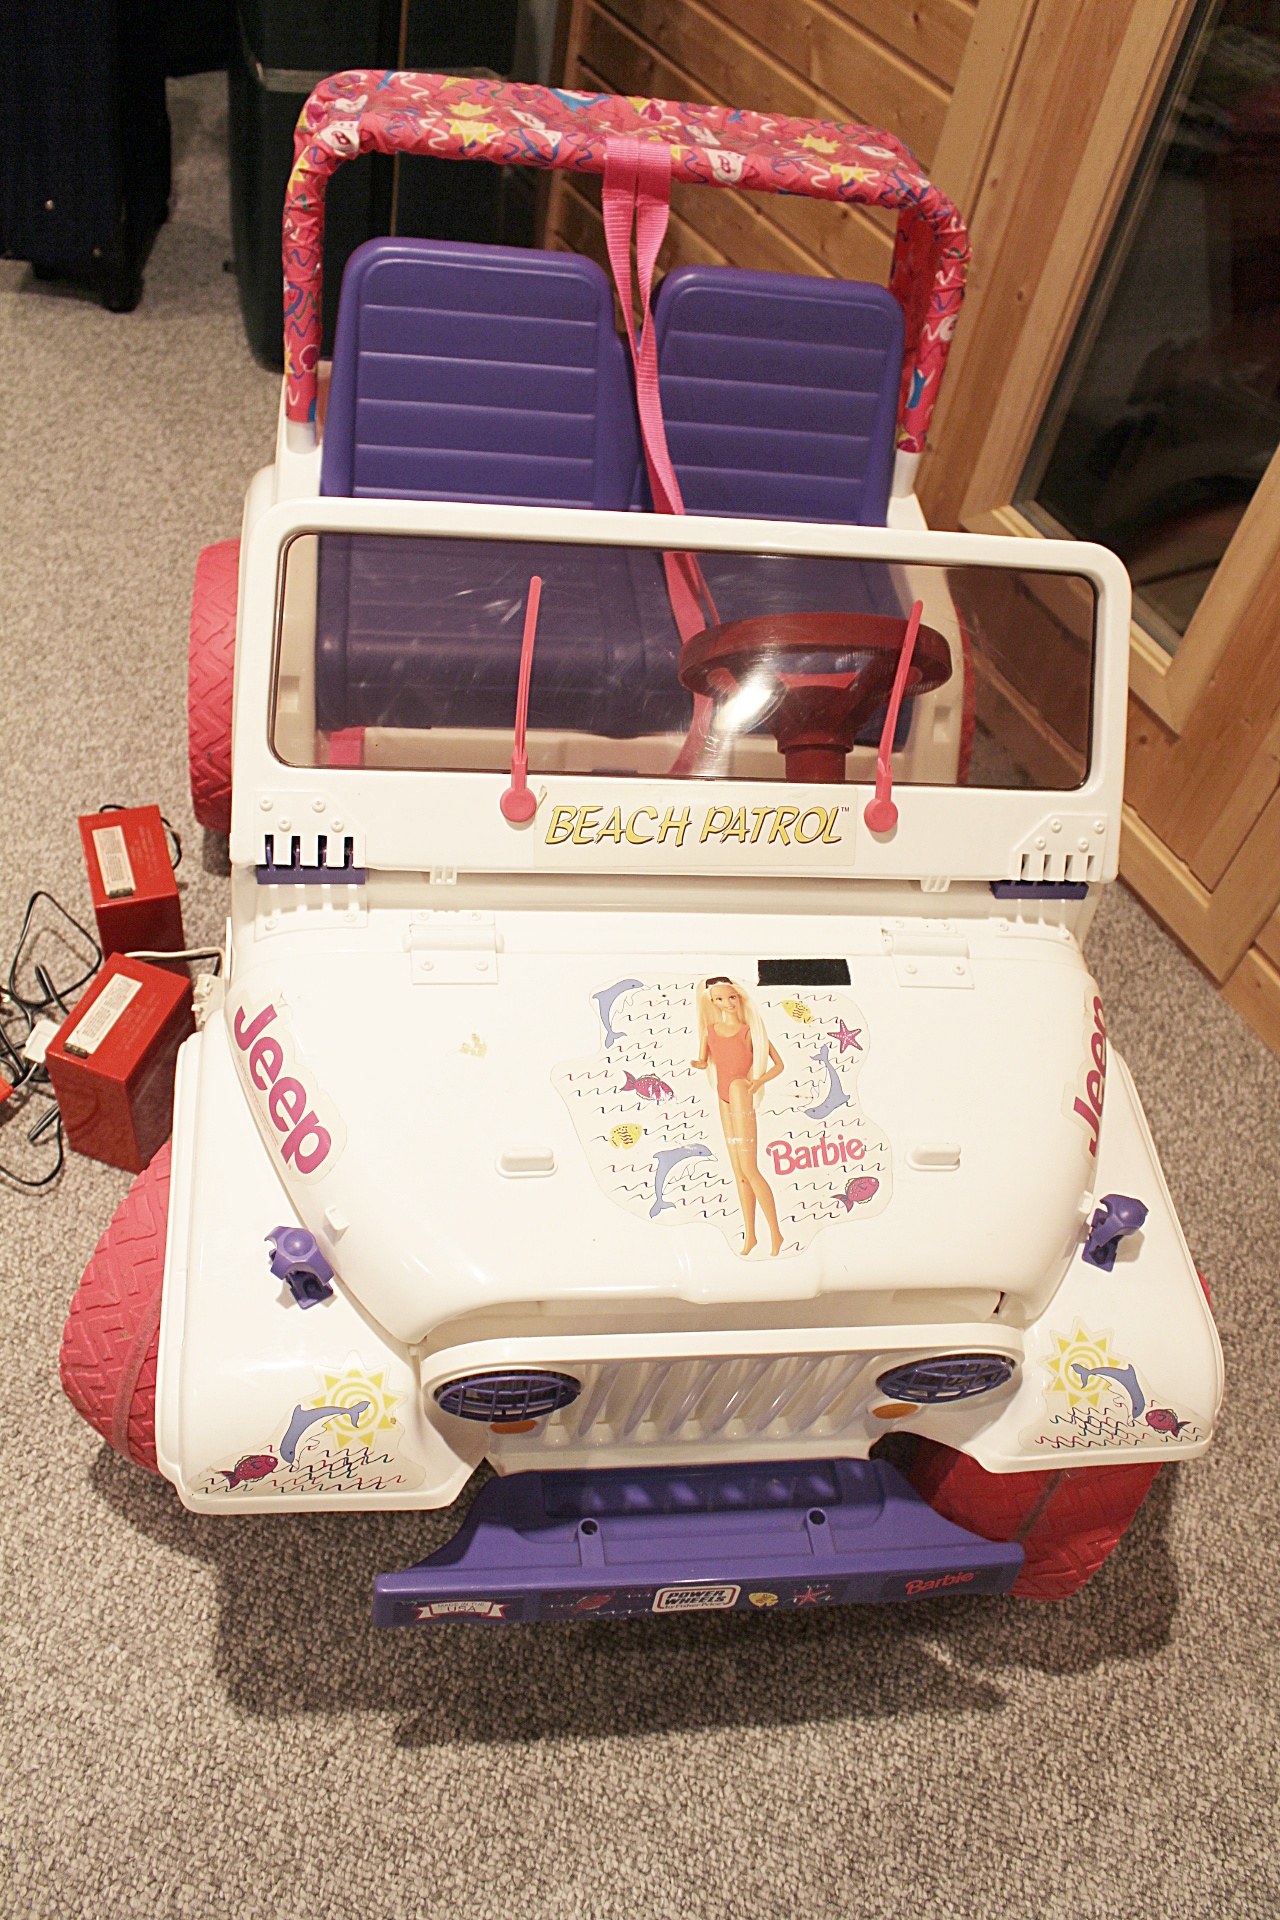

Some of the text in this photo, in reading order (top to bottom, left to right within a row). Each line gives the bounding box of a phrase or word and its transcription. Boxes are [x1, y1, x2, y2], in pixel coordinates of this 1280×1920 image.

[545, 805, 693, 847] BEACH
[234, 1003, 332, 1175] Jeep
[765, 1133, 866, 1176] Barbie
[667, 1590, 726, 1599] POWER
[905, 1571, 975, 1596] Barbie
[664, 1596, 726, 1605] WHEELS
